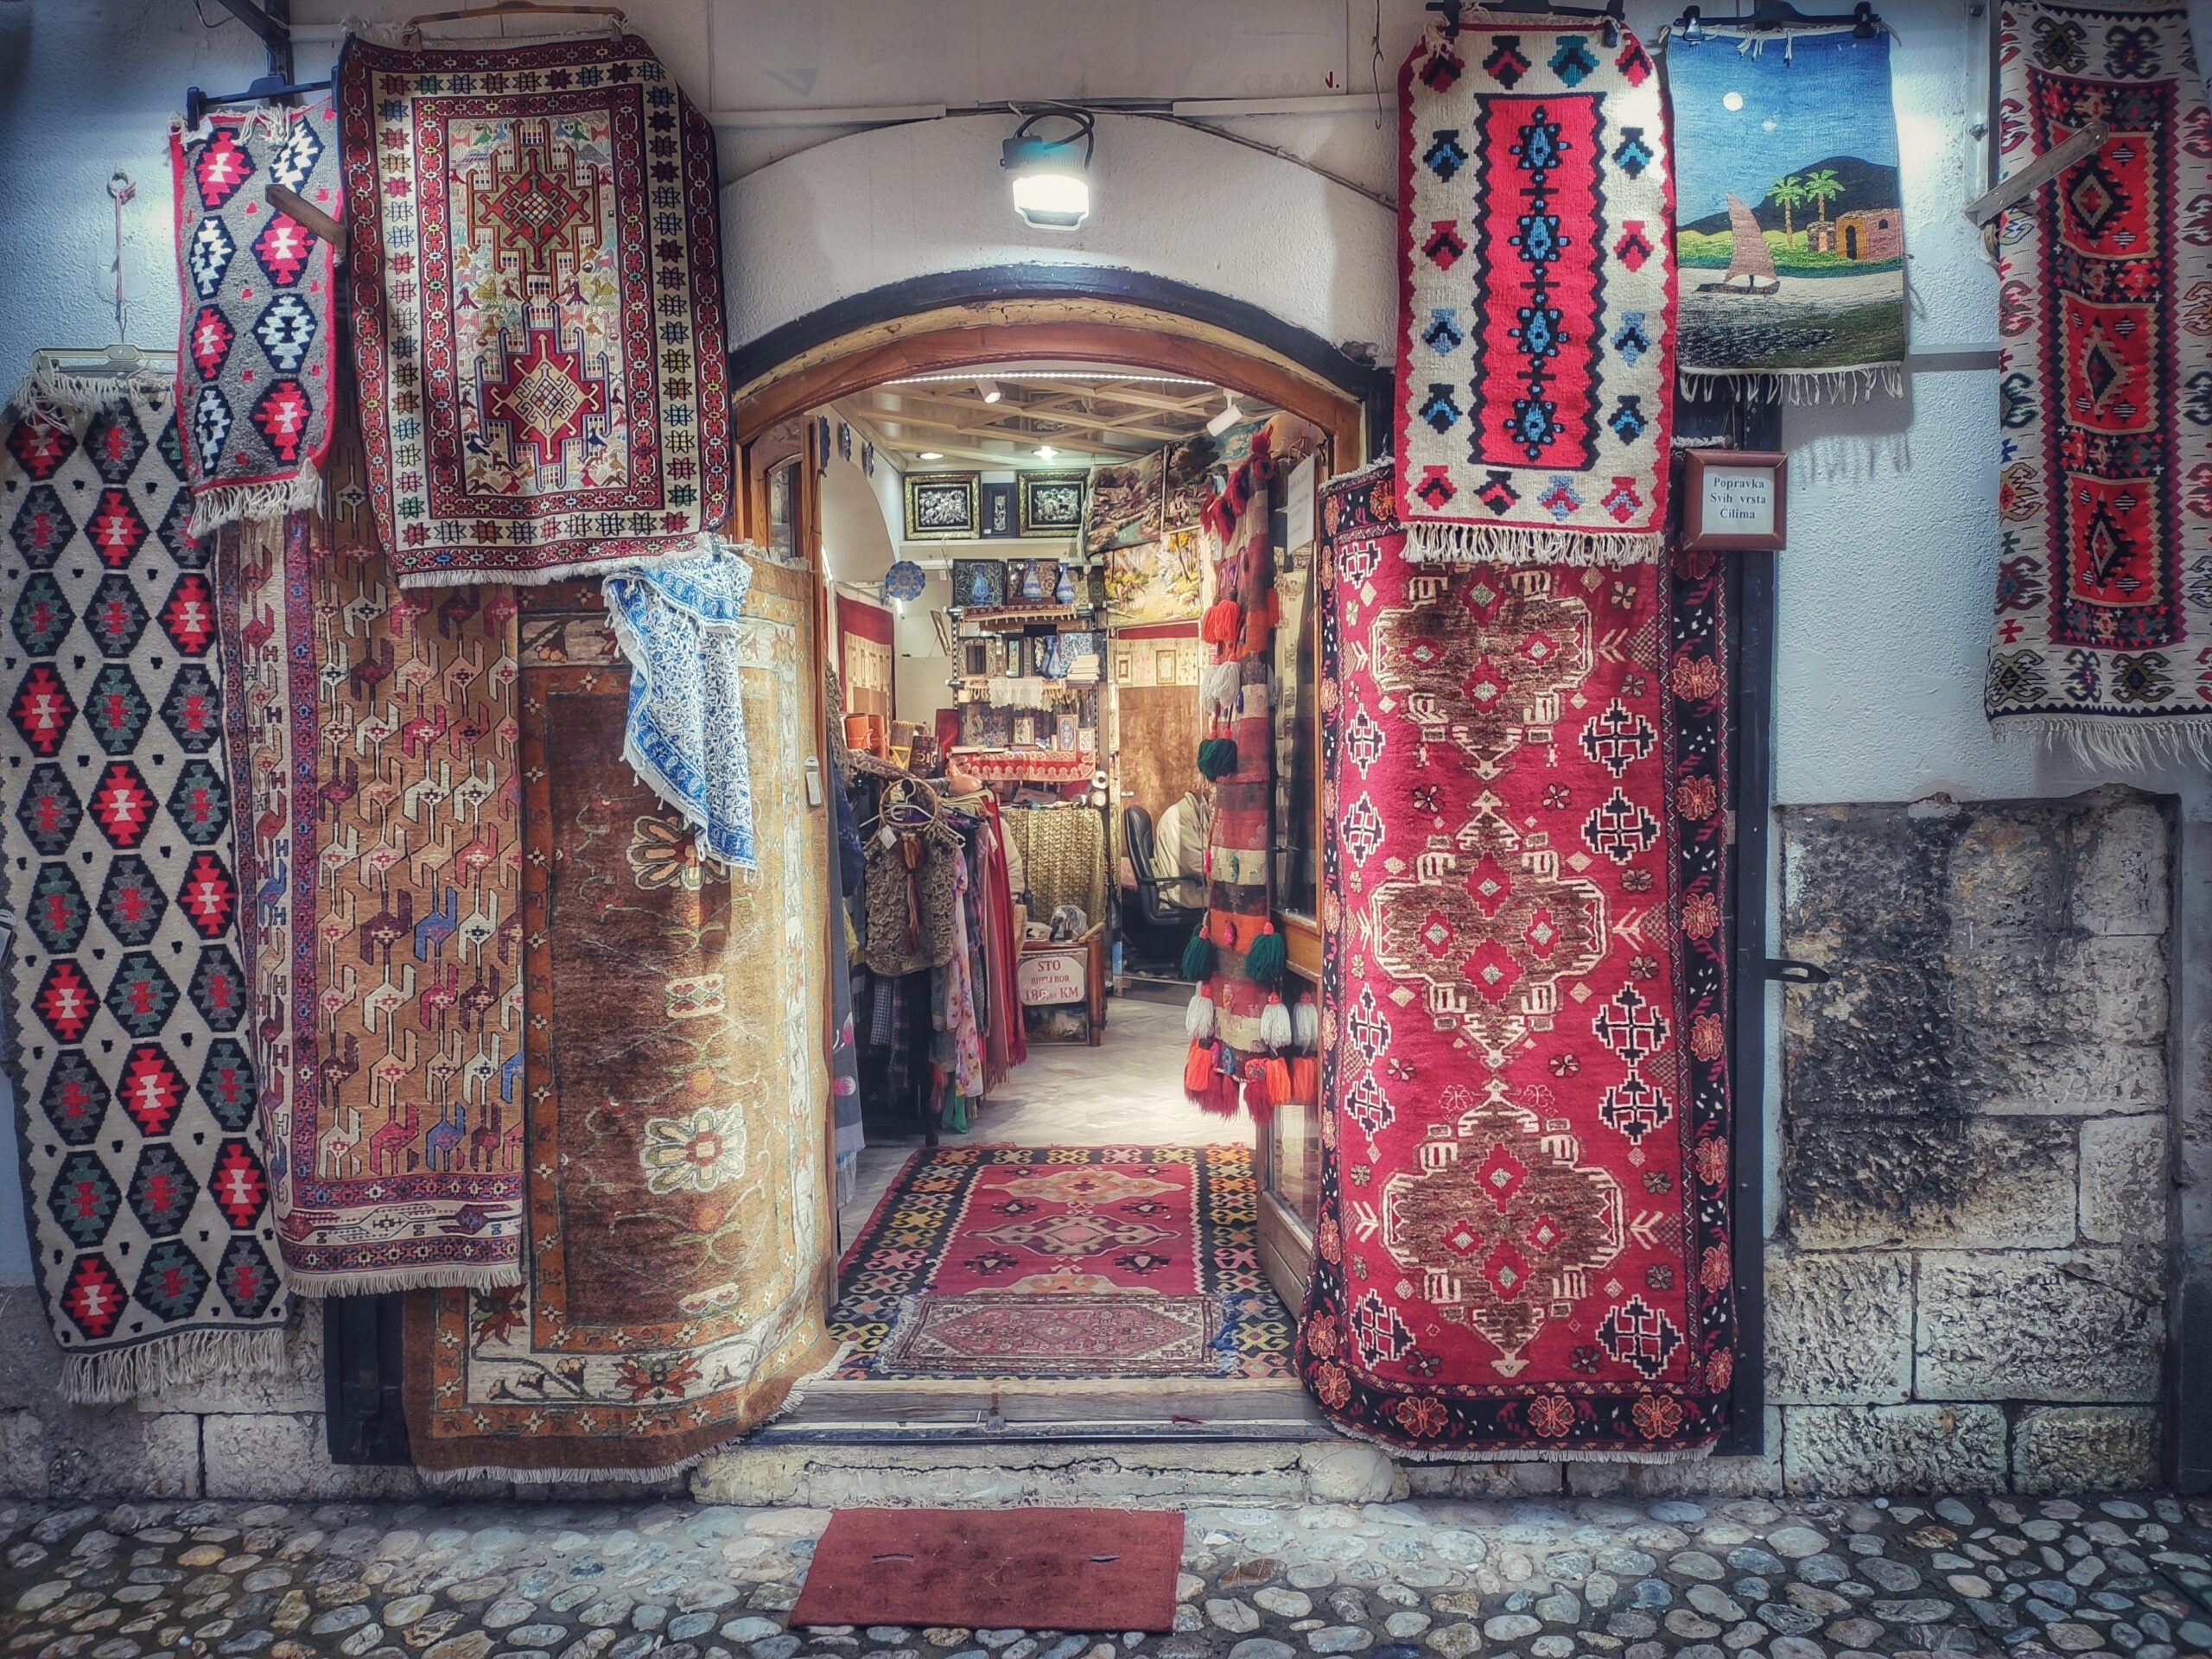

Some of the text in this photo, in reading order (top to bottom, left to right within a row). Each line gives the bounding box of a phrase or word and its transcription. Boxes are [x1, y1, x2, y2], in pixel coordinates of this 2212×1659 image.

[1714, 477, 1764, 490] Popravka
[1710, 492, 1766, 504] Svih vrsta
[1038, 960, 1061, 972] STO
[1059, 986, 1079, 999] KM
